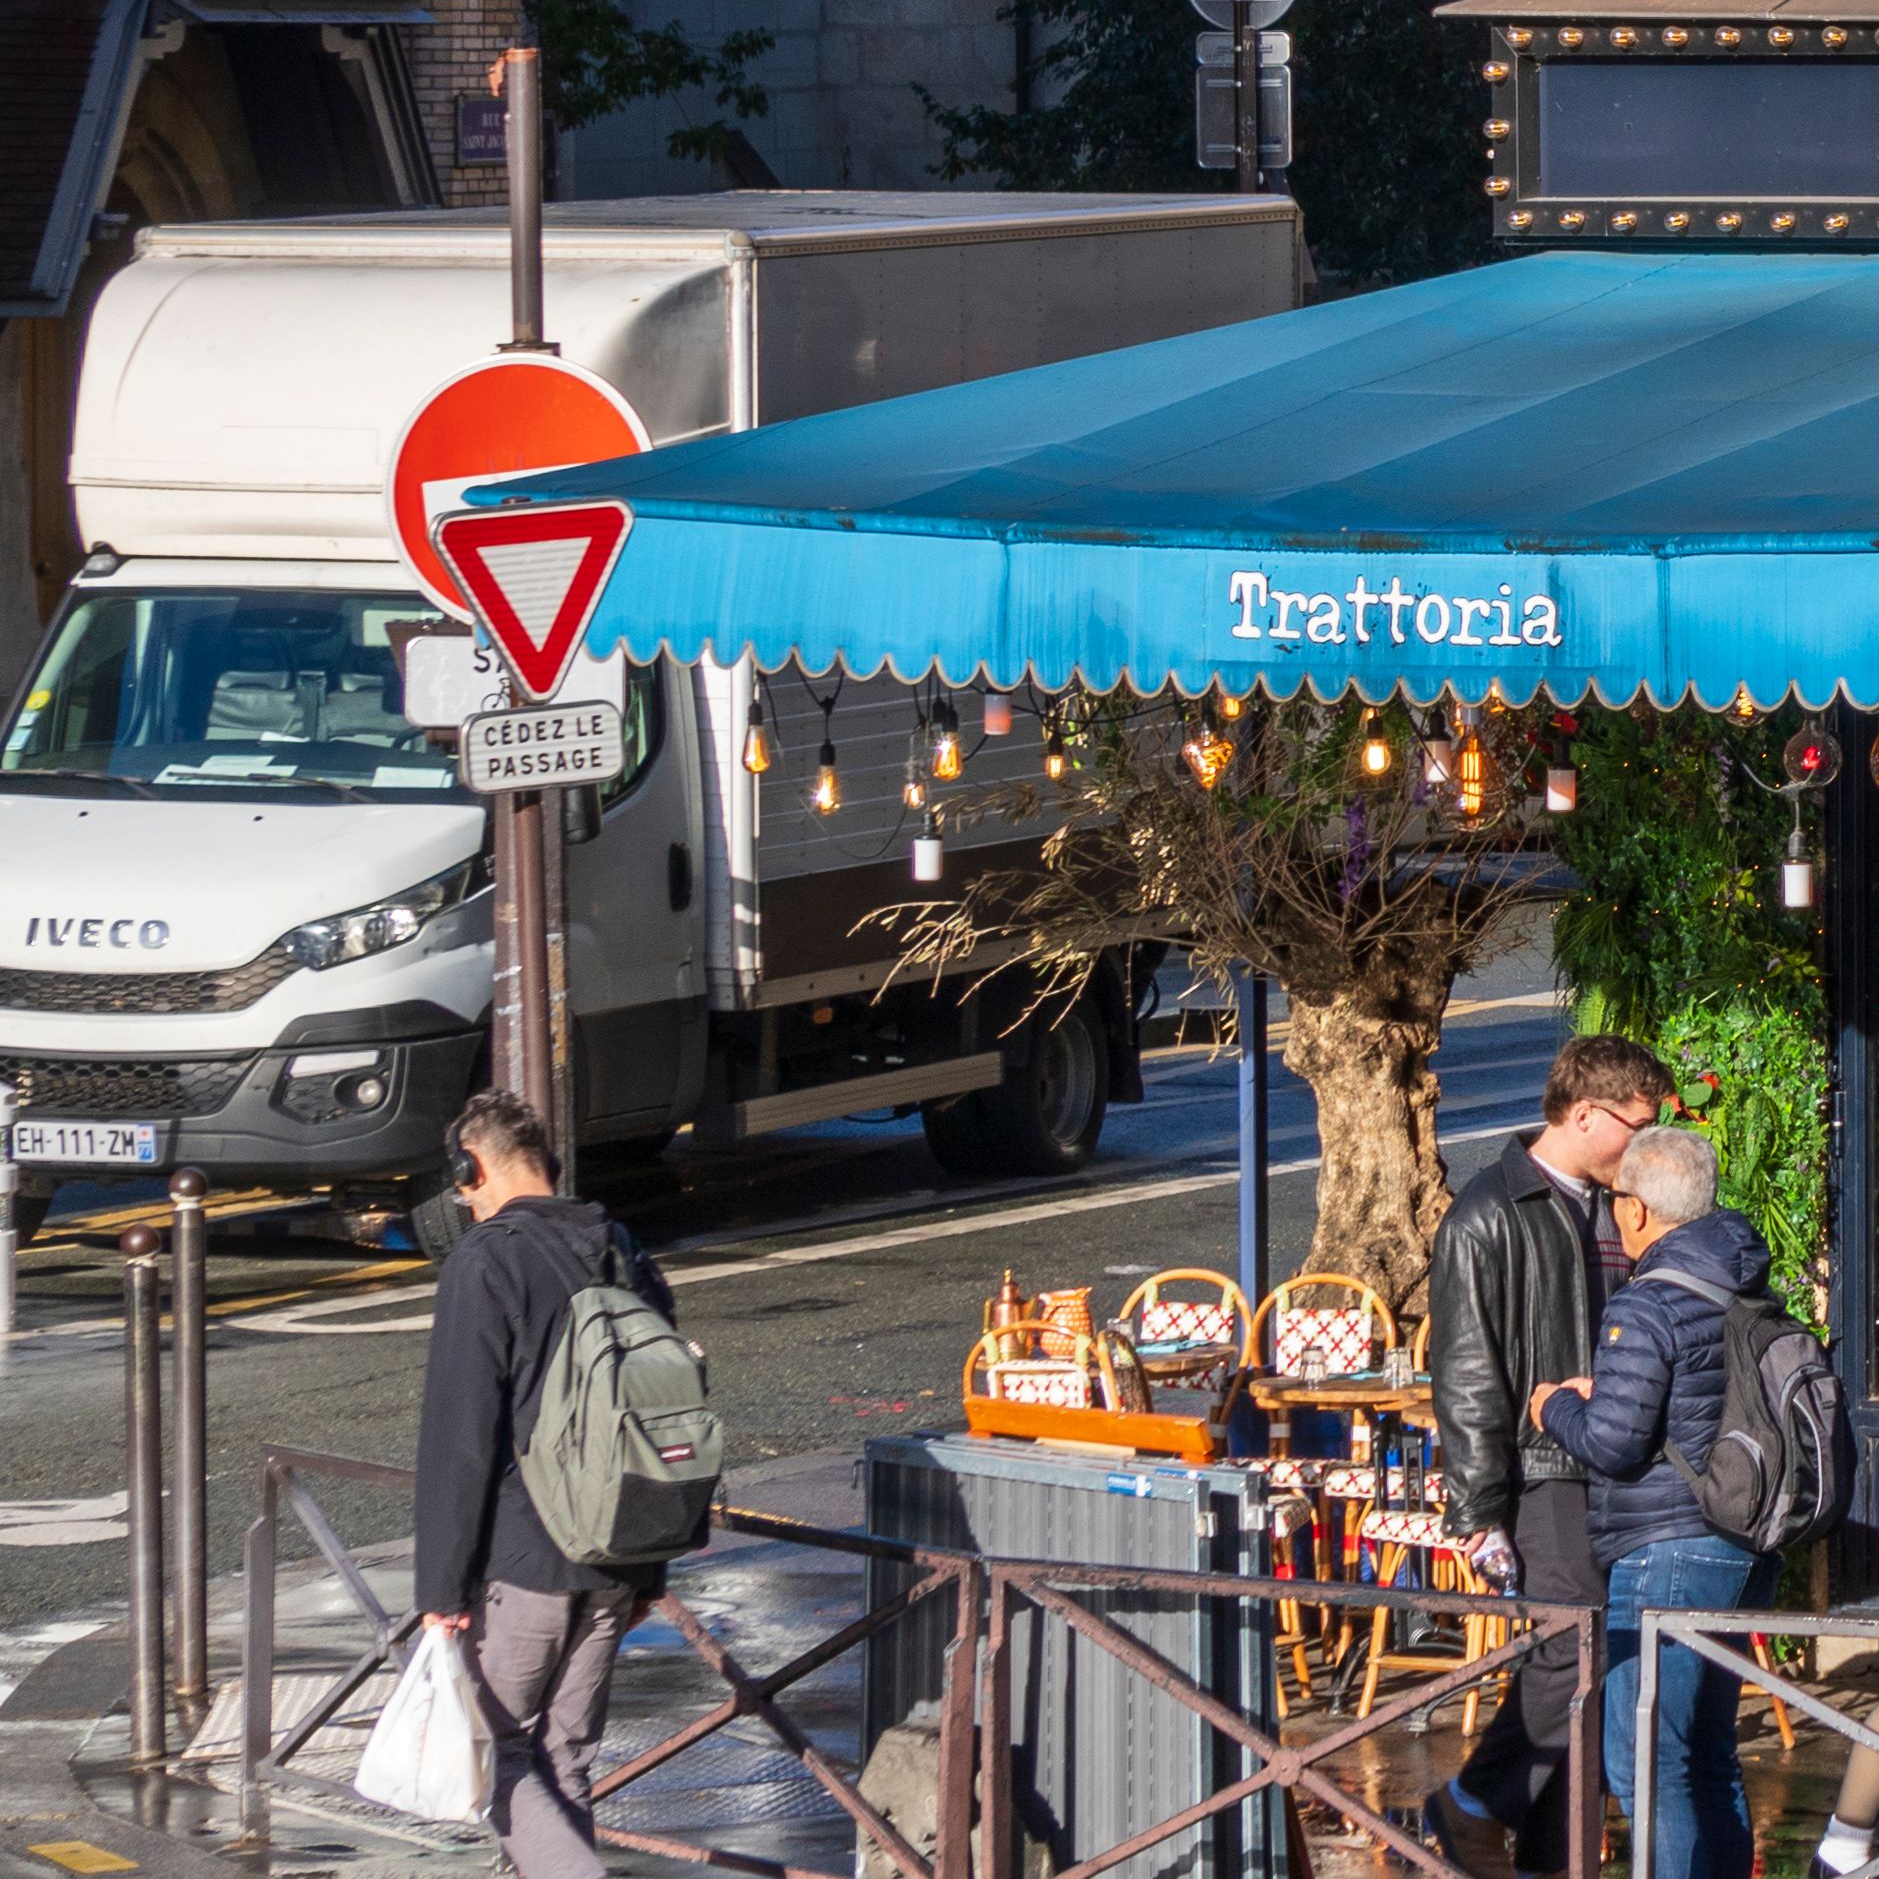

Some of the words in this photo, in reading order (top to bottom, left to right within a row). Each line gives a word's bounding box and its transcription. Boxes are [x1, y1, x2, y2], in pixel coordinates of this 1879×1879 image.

[1229, 569, 1564, 648] Trattoria
[484, 718, 565, 748] CÉDEZ
[576, 714, 604, 738] LE
[488, 746, 603, 779] PASSAGE
[25, 917, 171, 950] IVECO
[17, 1128, 136, 1156] EH-111-ZM
